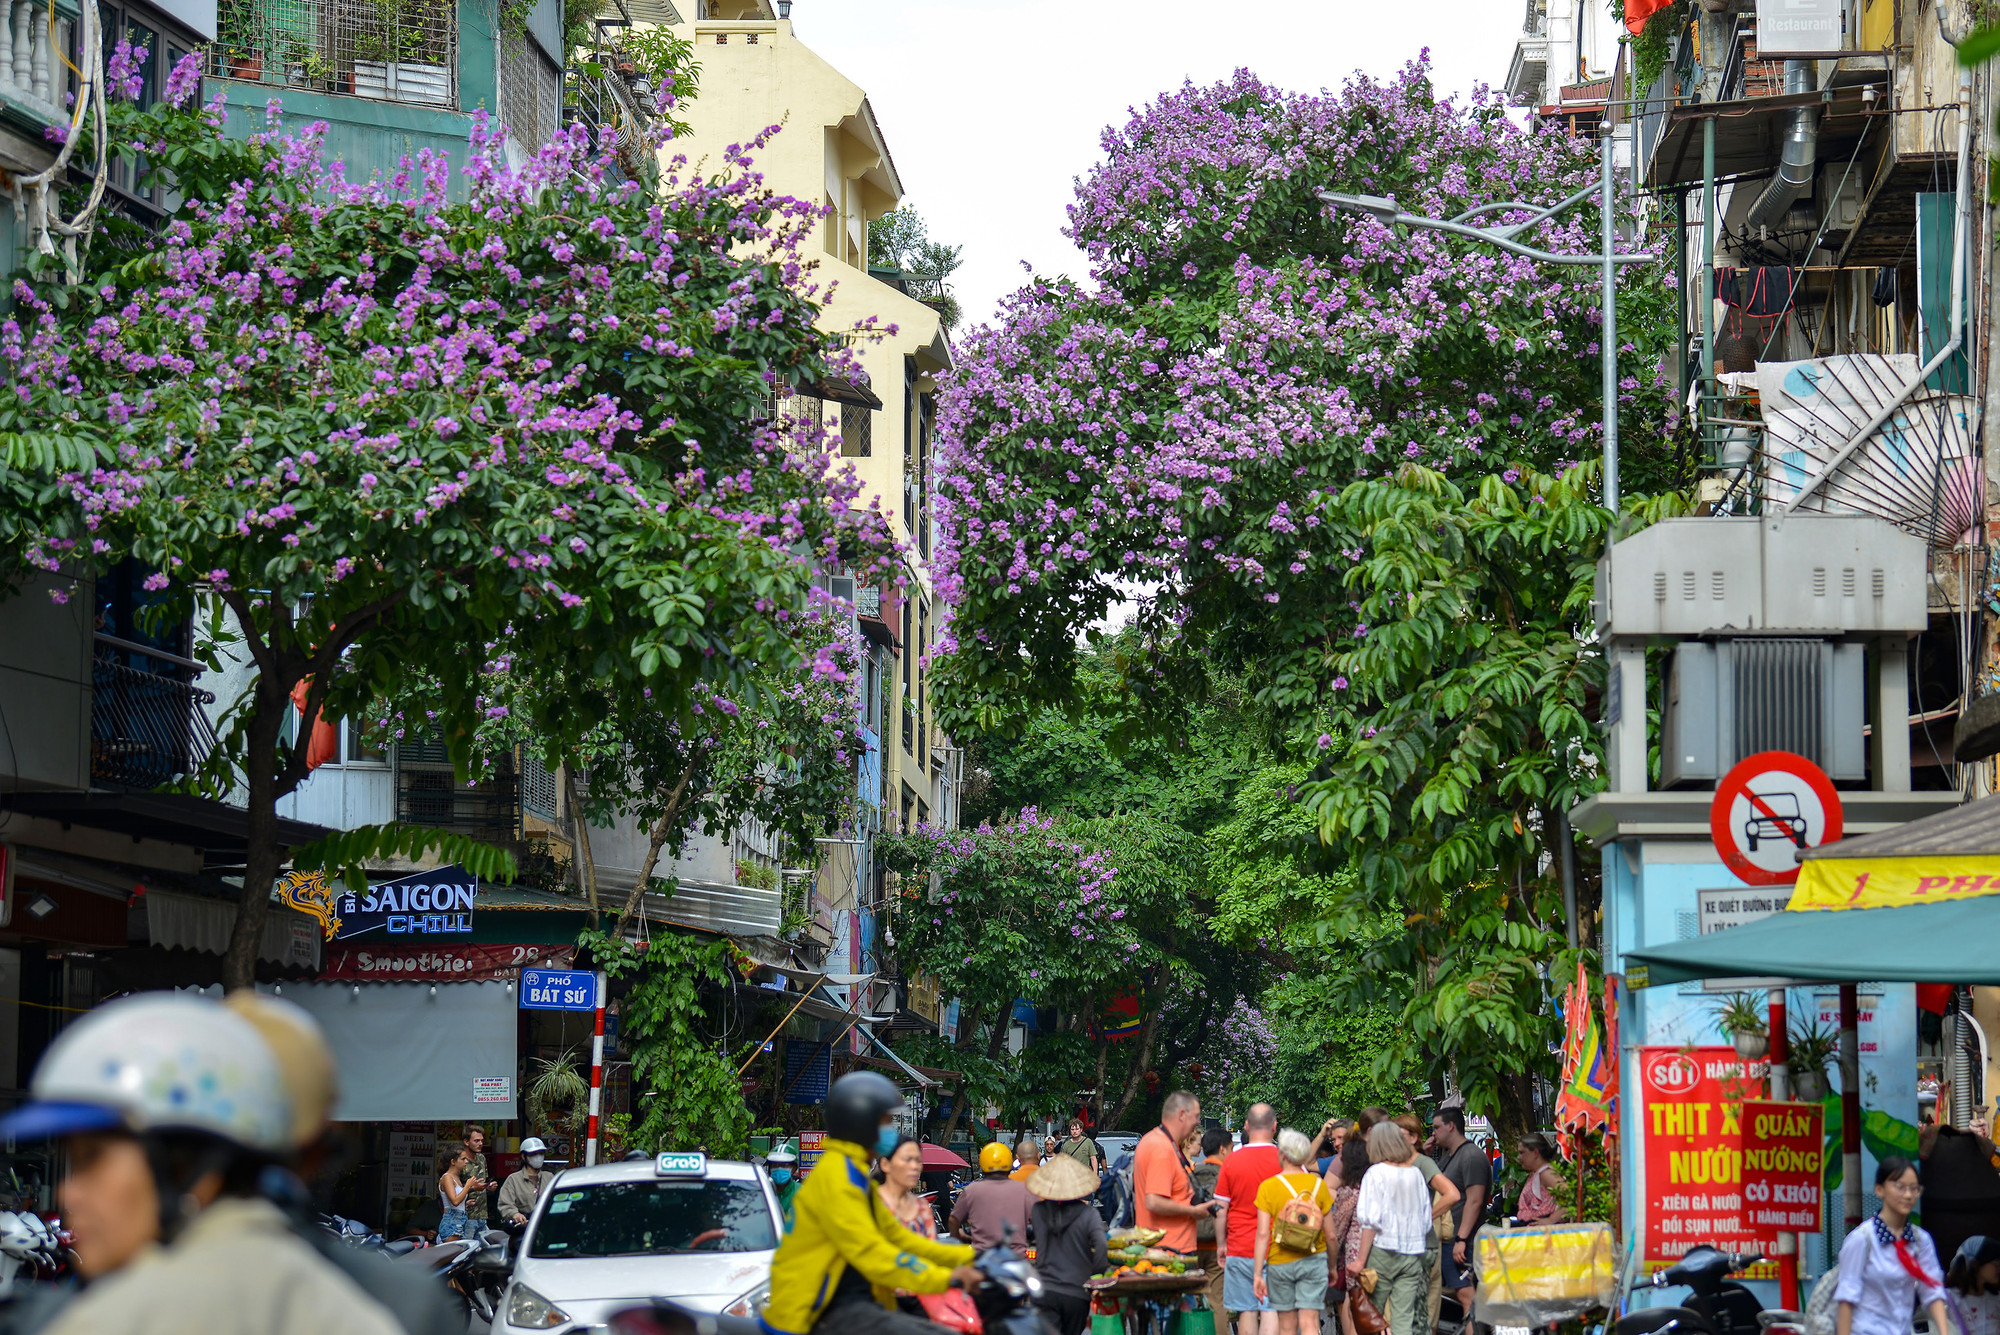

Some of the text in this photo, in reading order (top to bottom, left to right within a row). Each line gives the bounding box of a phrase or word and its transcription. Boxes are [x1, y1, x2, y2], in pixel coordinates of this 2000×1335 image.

[1768, 17, 1833, 32] Restaurant
[361, 884, 475, 913] SAIGON
[1705, 901, 1716, 914] XE
[387, 915, 473, 933] CHILL
[357, 951, 466, 973] Smoothie
[511, 946, 539, 965] 28
[547, 975, 572, 986] PHỐ
[530, 986, 588, 1004] BÁT SỨ
[1819, 1012, 1831, 1022] XE
[1654, 1059, 1682, 1086] SỐ
[1648, 1103, 1711, 1143] THỊT
[1754, 1110, 1811, 1141] QUÁN
[801, 1133, 823, 1143] MONEY
[662, 1156, 700, 1170] Grab
[1744, 1144, 1820, 1174] NƯỚNG
[1745, 1179, 1818, 1204] CÓ KHÓI
[1662, 1192, 1690, 1210] XIÊN
[1691, 1192, 1709, 1210] GÀ
[1748, 1210, 1754, 1223] 1
[1757, 1207, 1787, 1224] HÀNG
